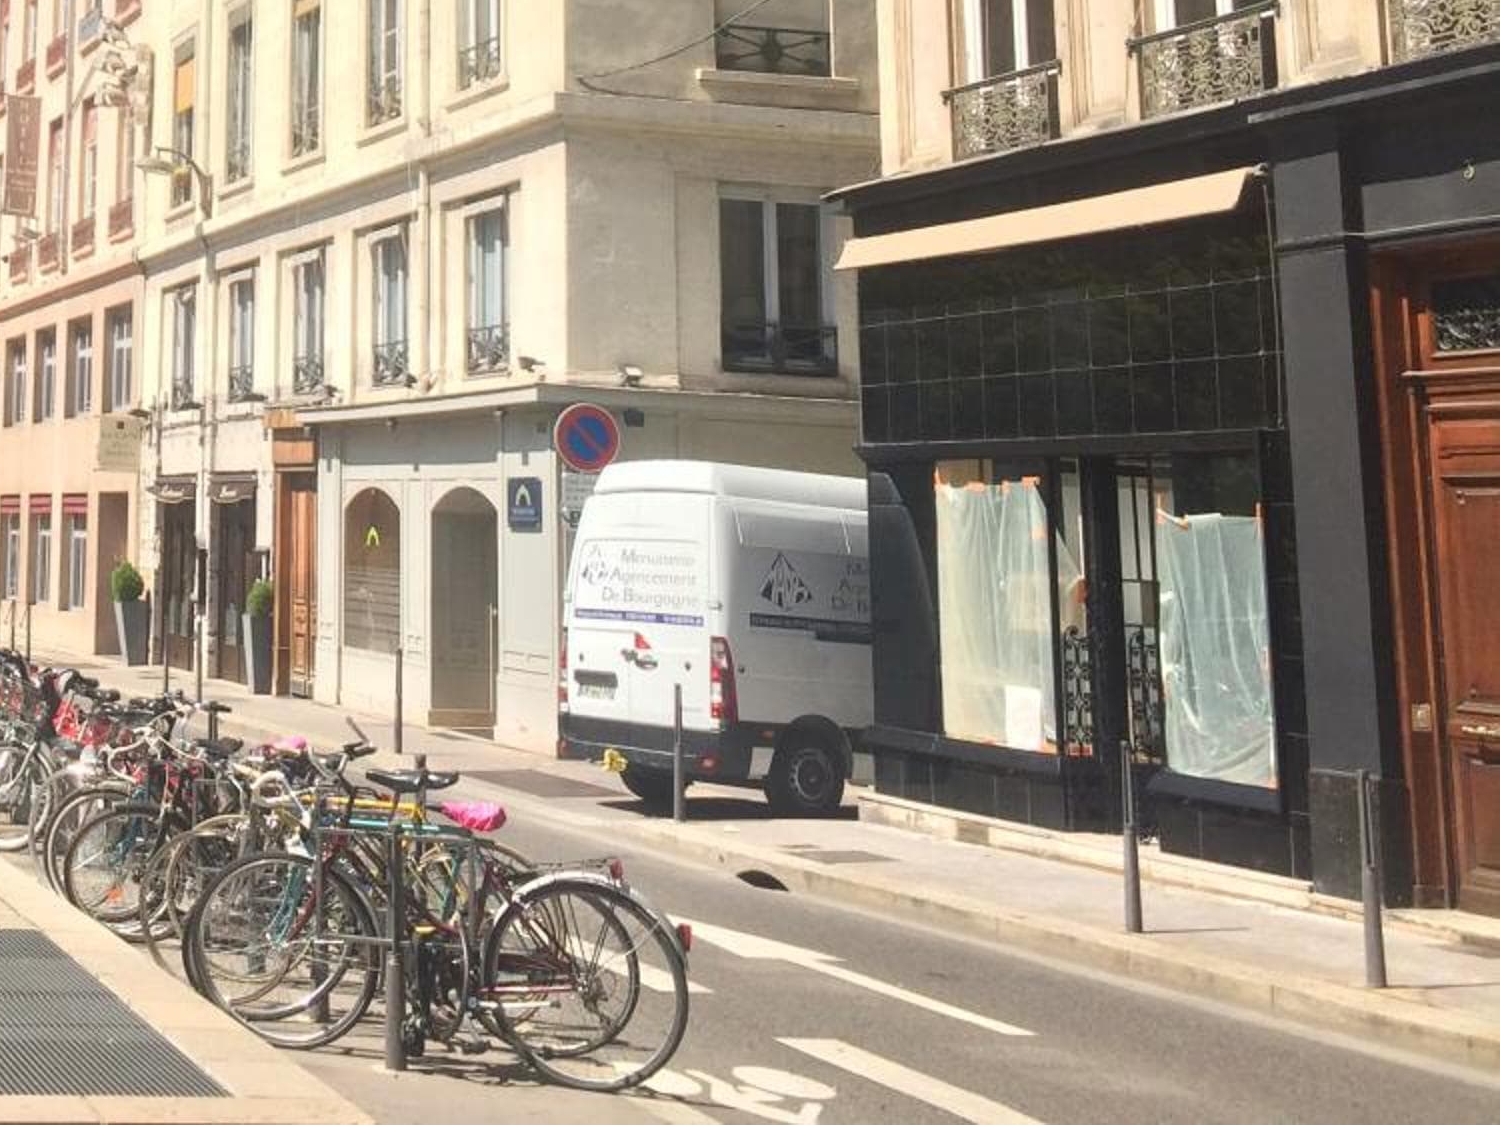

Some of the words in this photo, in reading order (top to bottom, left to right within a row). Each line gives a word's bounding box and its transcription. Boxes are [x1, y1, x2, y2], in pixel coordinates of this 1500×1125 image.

[620, 548, 696, 566] Menuiserie
[610, 567, 697, 587] Agencement
[622, 586, 701, 608] Bourgogne
